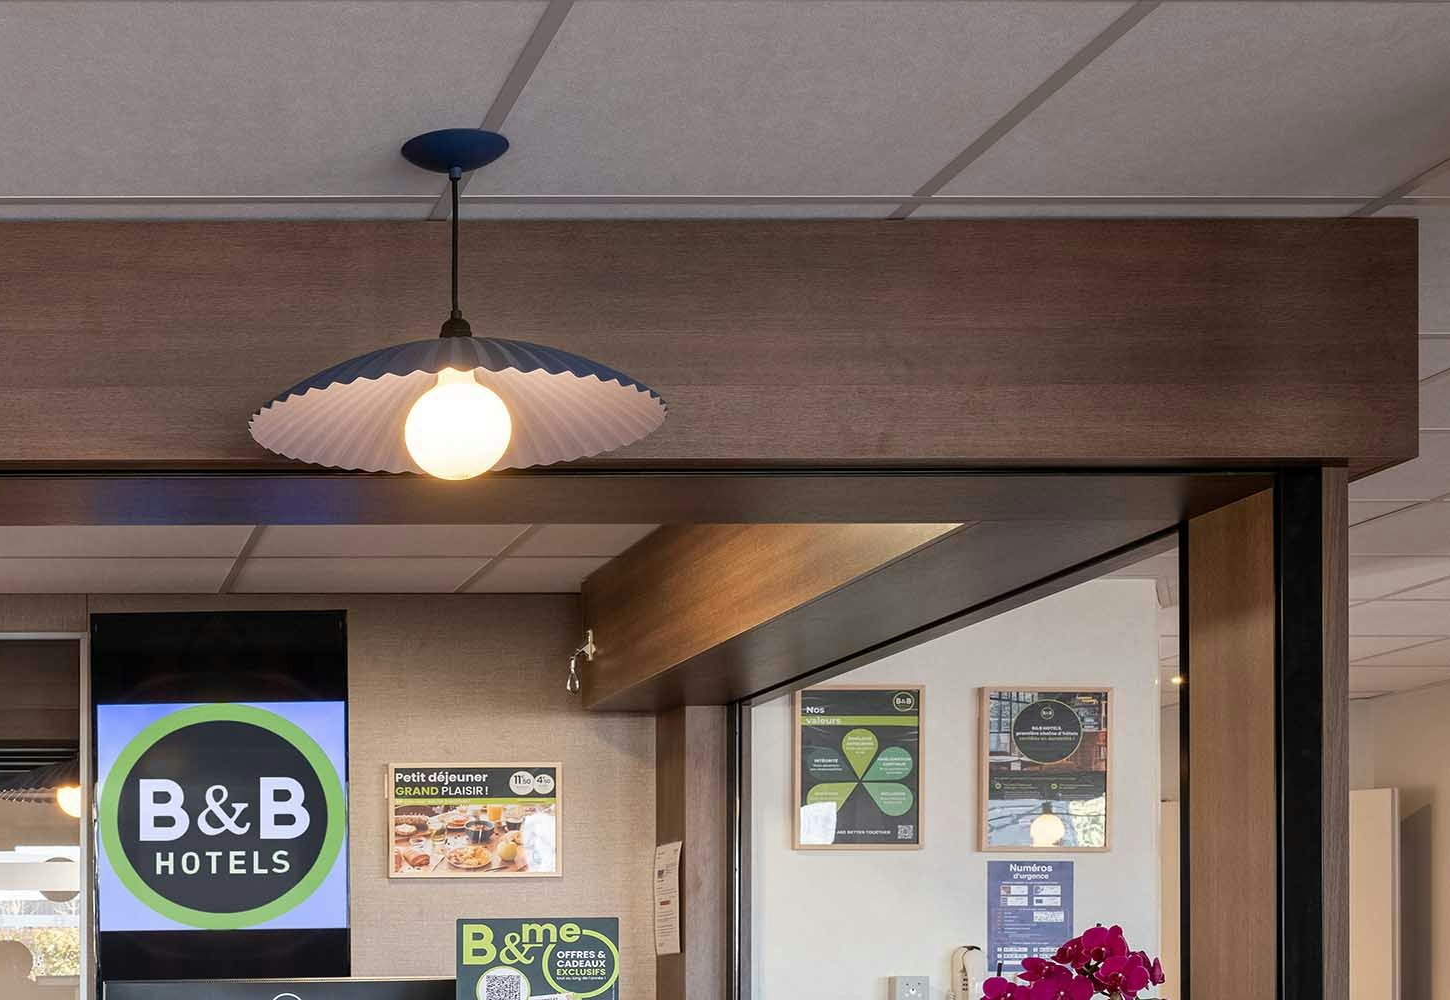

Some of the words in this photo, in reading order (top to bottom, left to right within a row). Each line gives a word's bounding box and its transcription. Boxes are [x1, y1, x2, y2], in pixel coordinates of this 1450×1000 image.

[806, 706, 825, 714] Nos
[805, 716, 842, 725] valeurs
[395, 771, 426, 782] Petit
[428, 771, 488, 785] déjeuner
[395, 786, 439, 796] GRAND
[441, 786, 483, 796] PLAISIR
[139, 776, 311, 842] B&B
[156, 850, 291, 875] HOTELS
[1009, 863, 1053, 872] Numéros
[556, 950, 595, 959] OFFRES
[597, 950, 606, 959] &
[556, 960, 606, 968] CADEAUX
[556, 968, 606, 976] EXCLUSIFS
